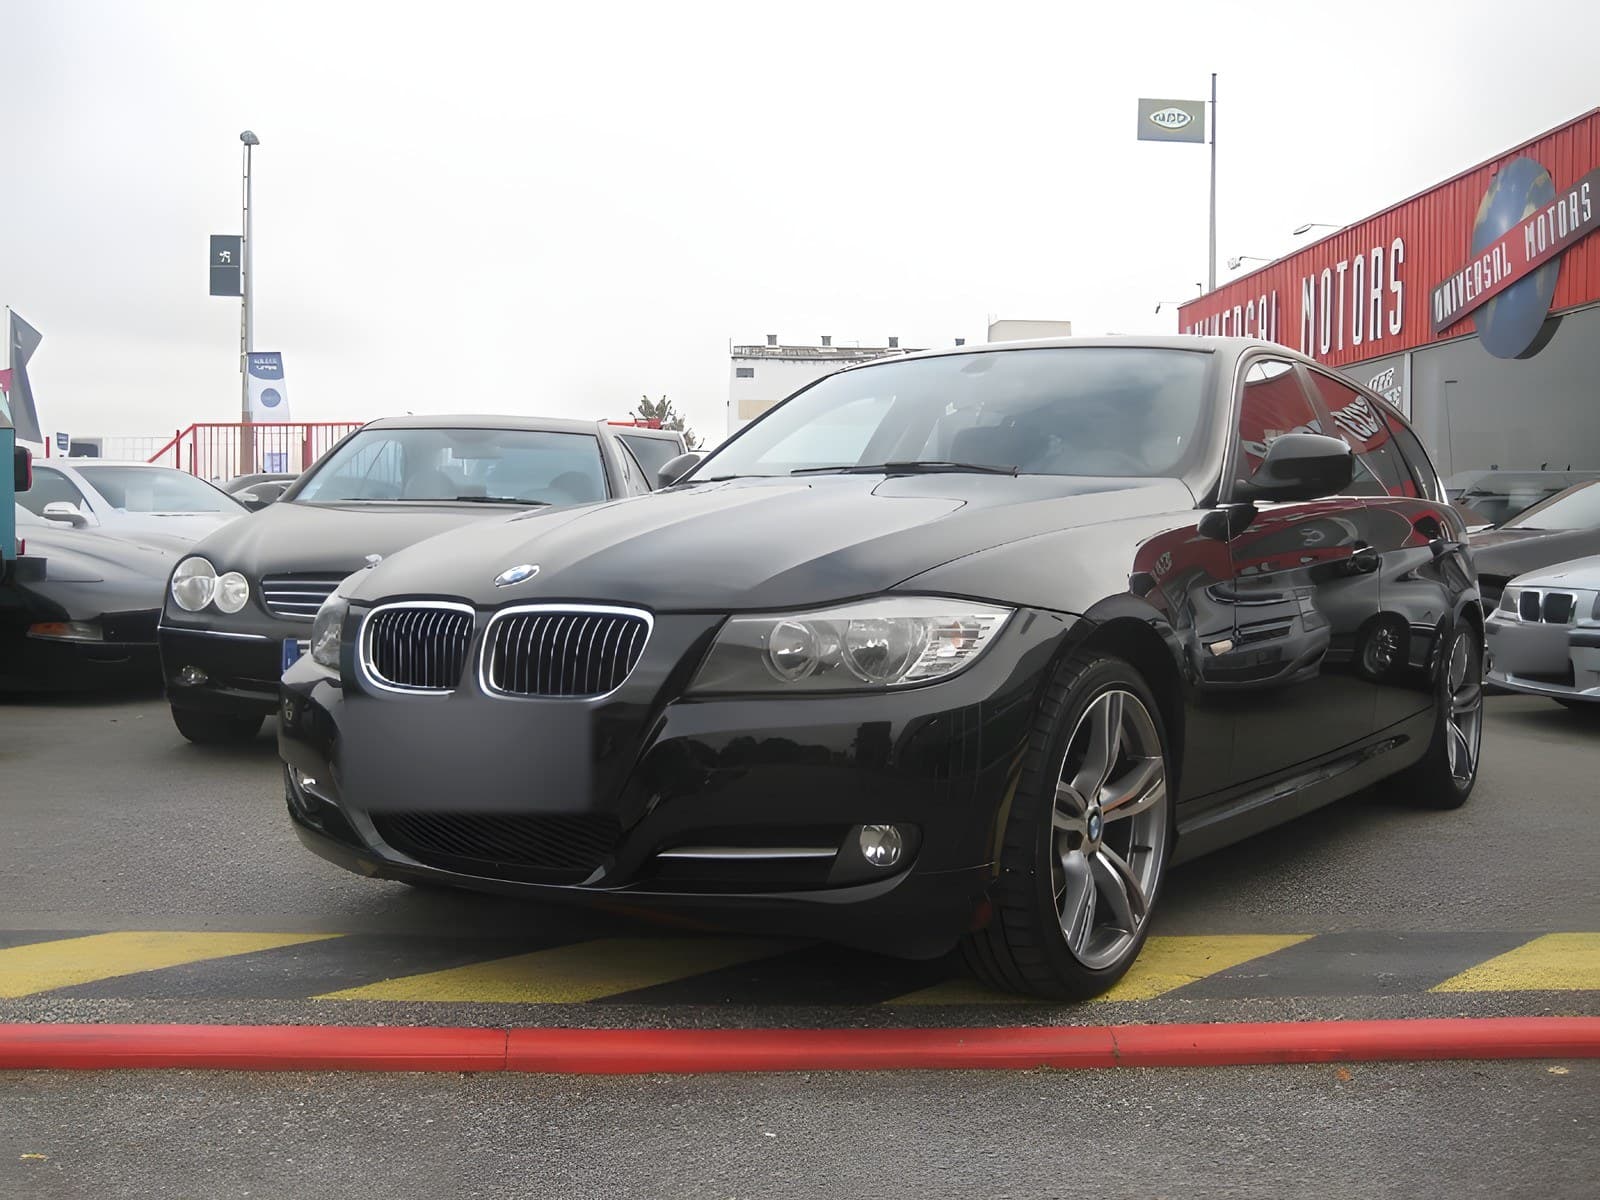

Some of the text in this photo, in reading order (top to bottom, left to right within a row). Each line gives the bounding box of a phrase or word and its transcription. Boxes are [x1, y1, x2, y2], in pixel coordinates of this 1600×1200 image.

[1300, 237, 1405, 358] MOTORS
[1434, 182, 1592, 323] UNIVERSAL MOTORS
